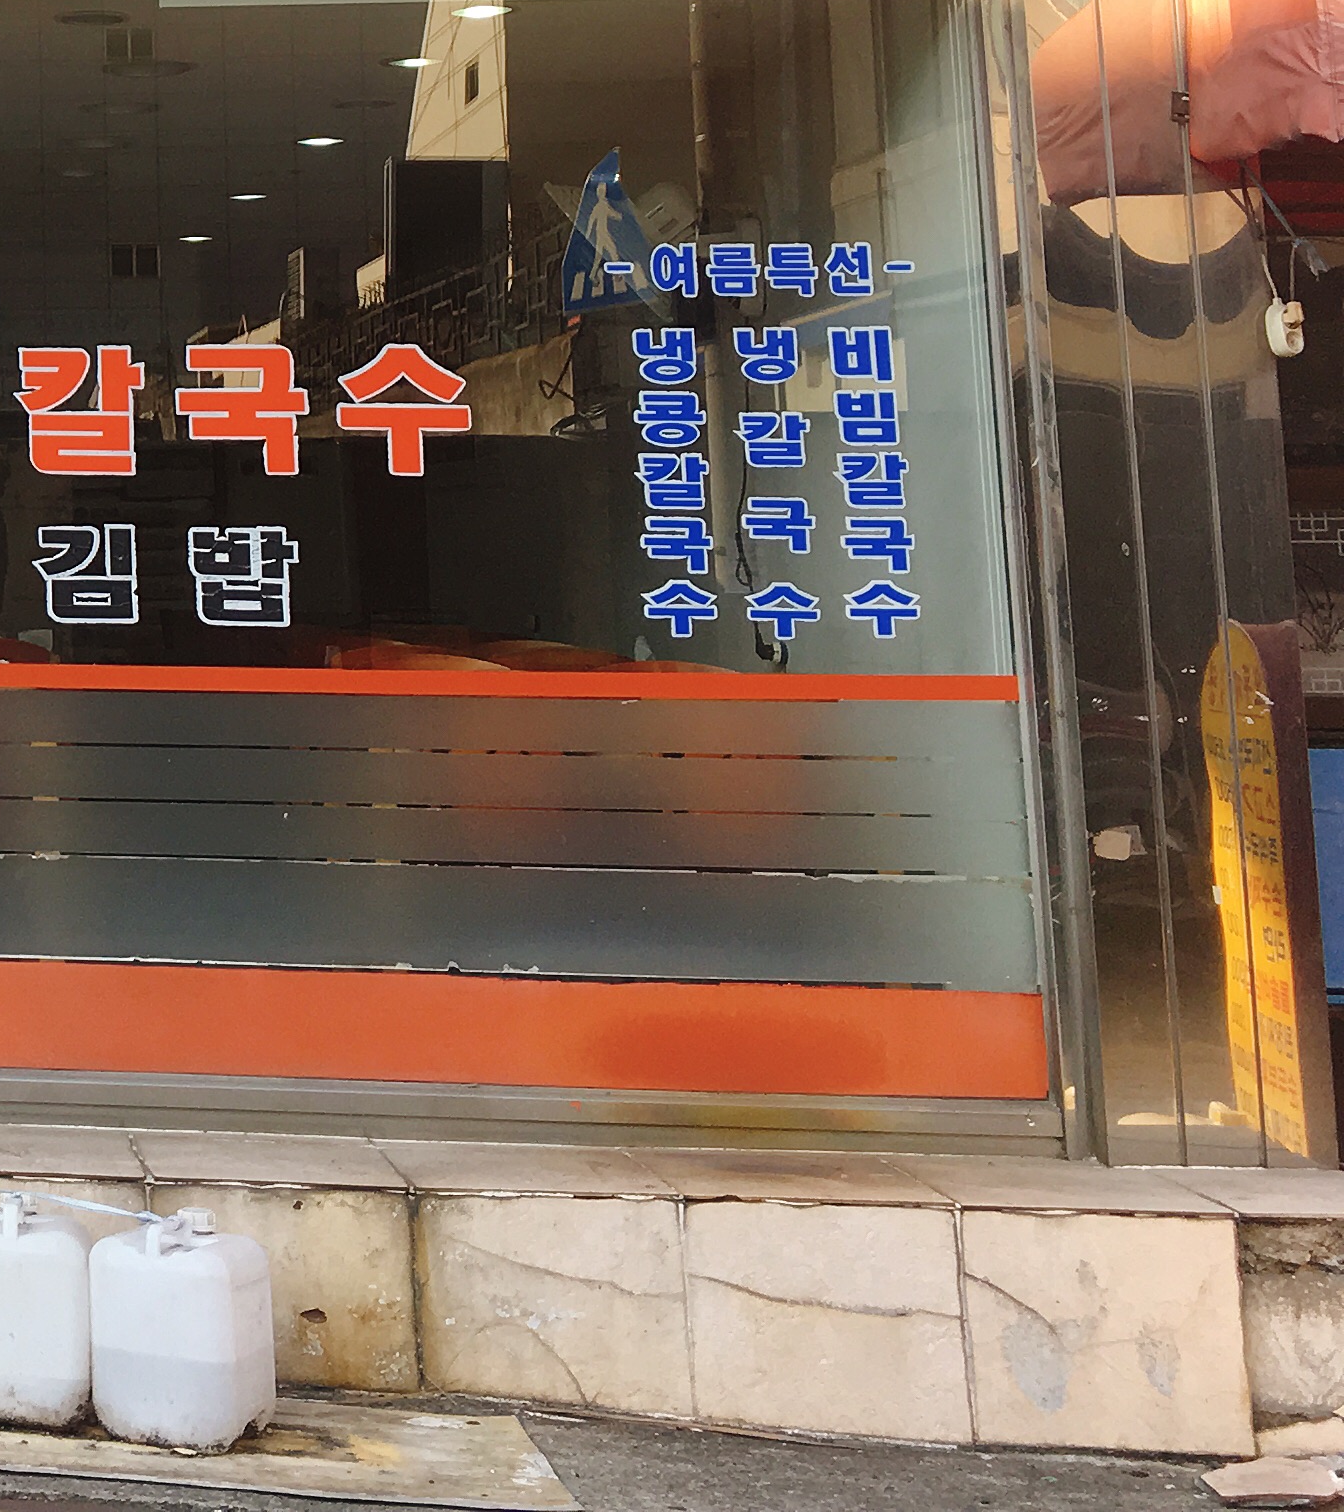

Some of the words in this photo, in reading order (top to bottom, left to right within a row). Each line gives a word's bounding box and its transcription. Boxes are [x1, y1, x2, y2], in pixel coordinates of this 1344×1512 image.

[30, 522, 301, 629] 김밥
[631, 327, 718, 638] 냉콩칼국수
[732, 326, 821, 641] 냉칼국수
[826, 325, 921, 639] 비빔칼국수
